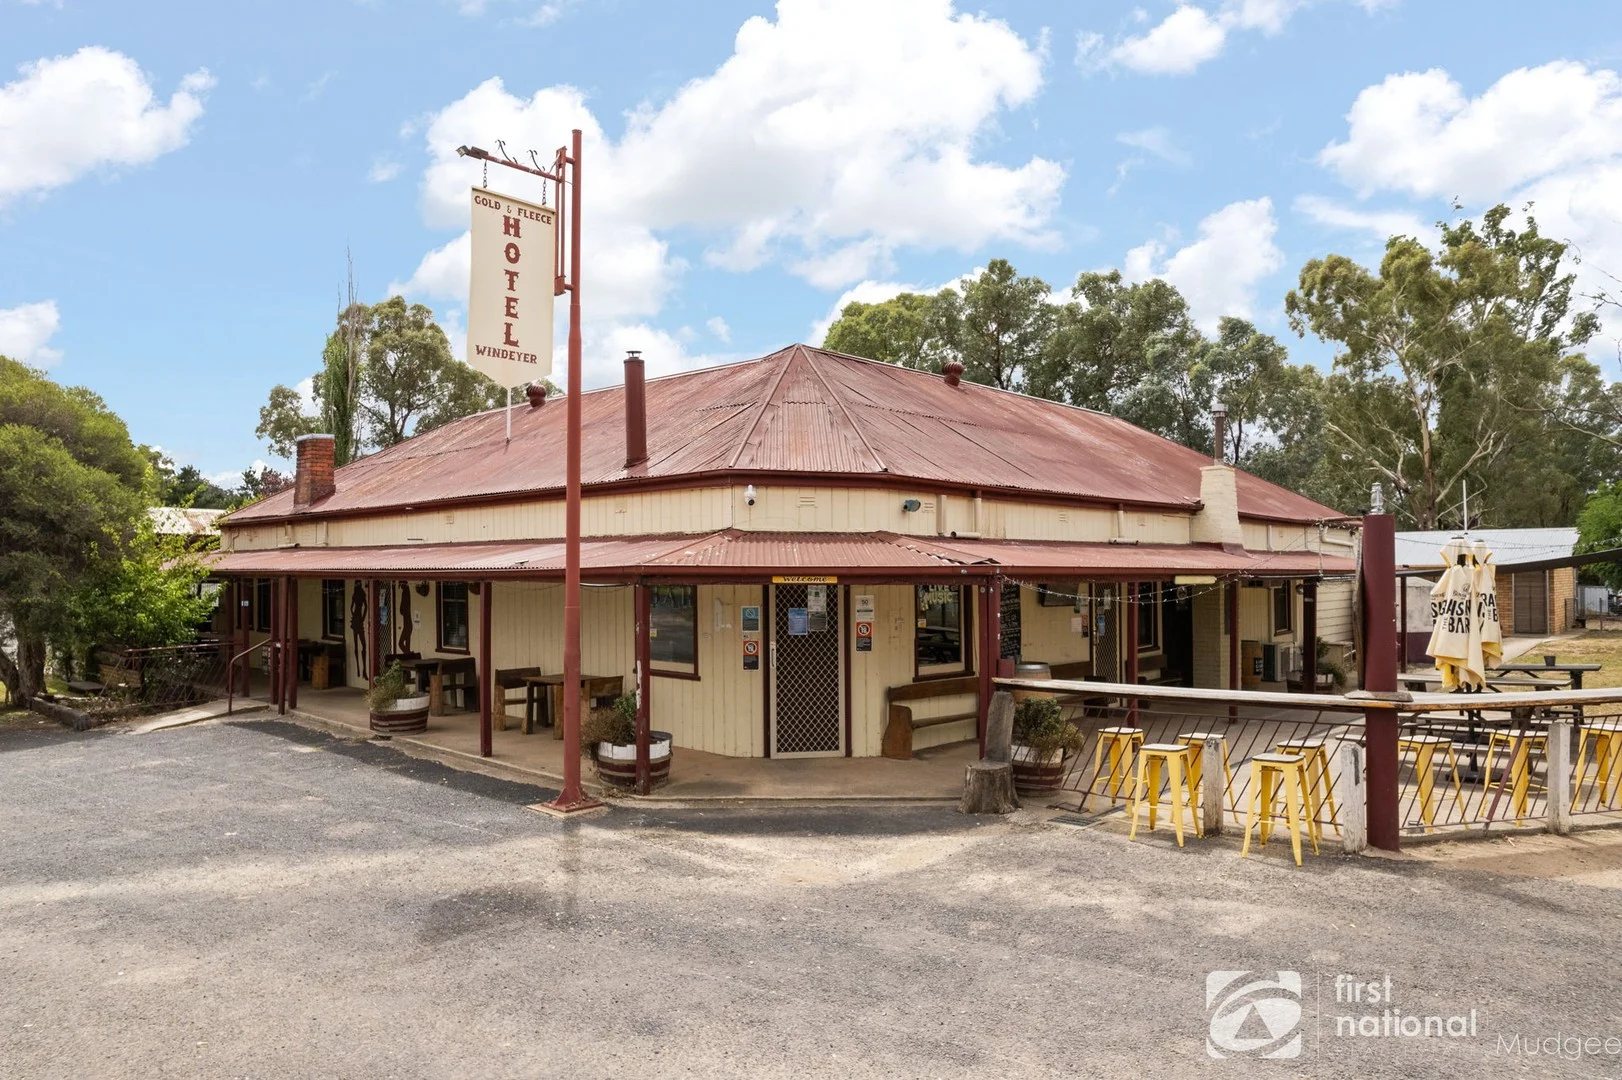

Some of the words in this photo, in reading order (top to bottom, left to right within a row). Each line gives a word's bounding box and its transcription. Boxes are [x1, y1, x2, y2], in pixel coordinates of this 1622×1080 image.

[474, 195, 501, 210] GOLD
[506, 205, 512, 214] &
[517, 207, 552, 225] FLEECE
[503, 214, 521, 348] HOTEL
[475, 344, 537, 365] WINDEYER
[1448, 616, 1470, 633] BAR
